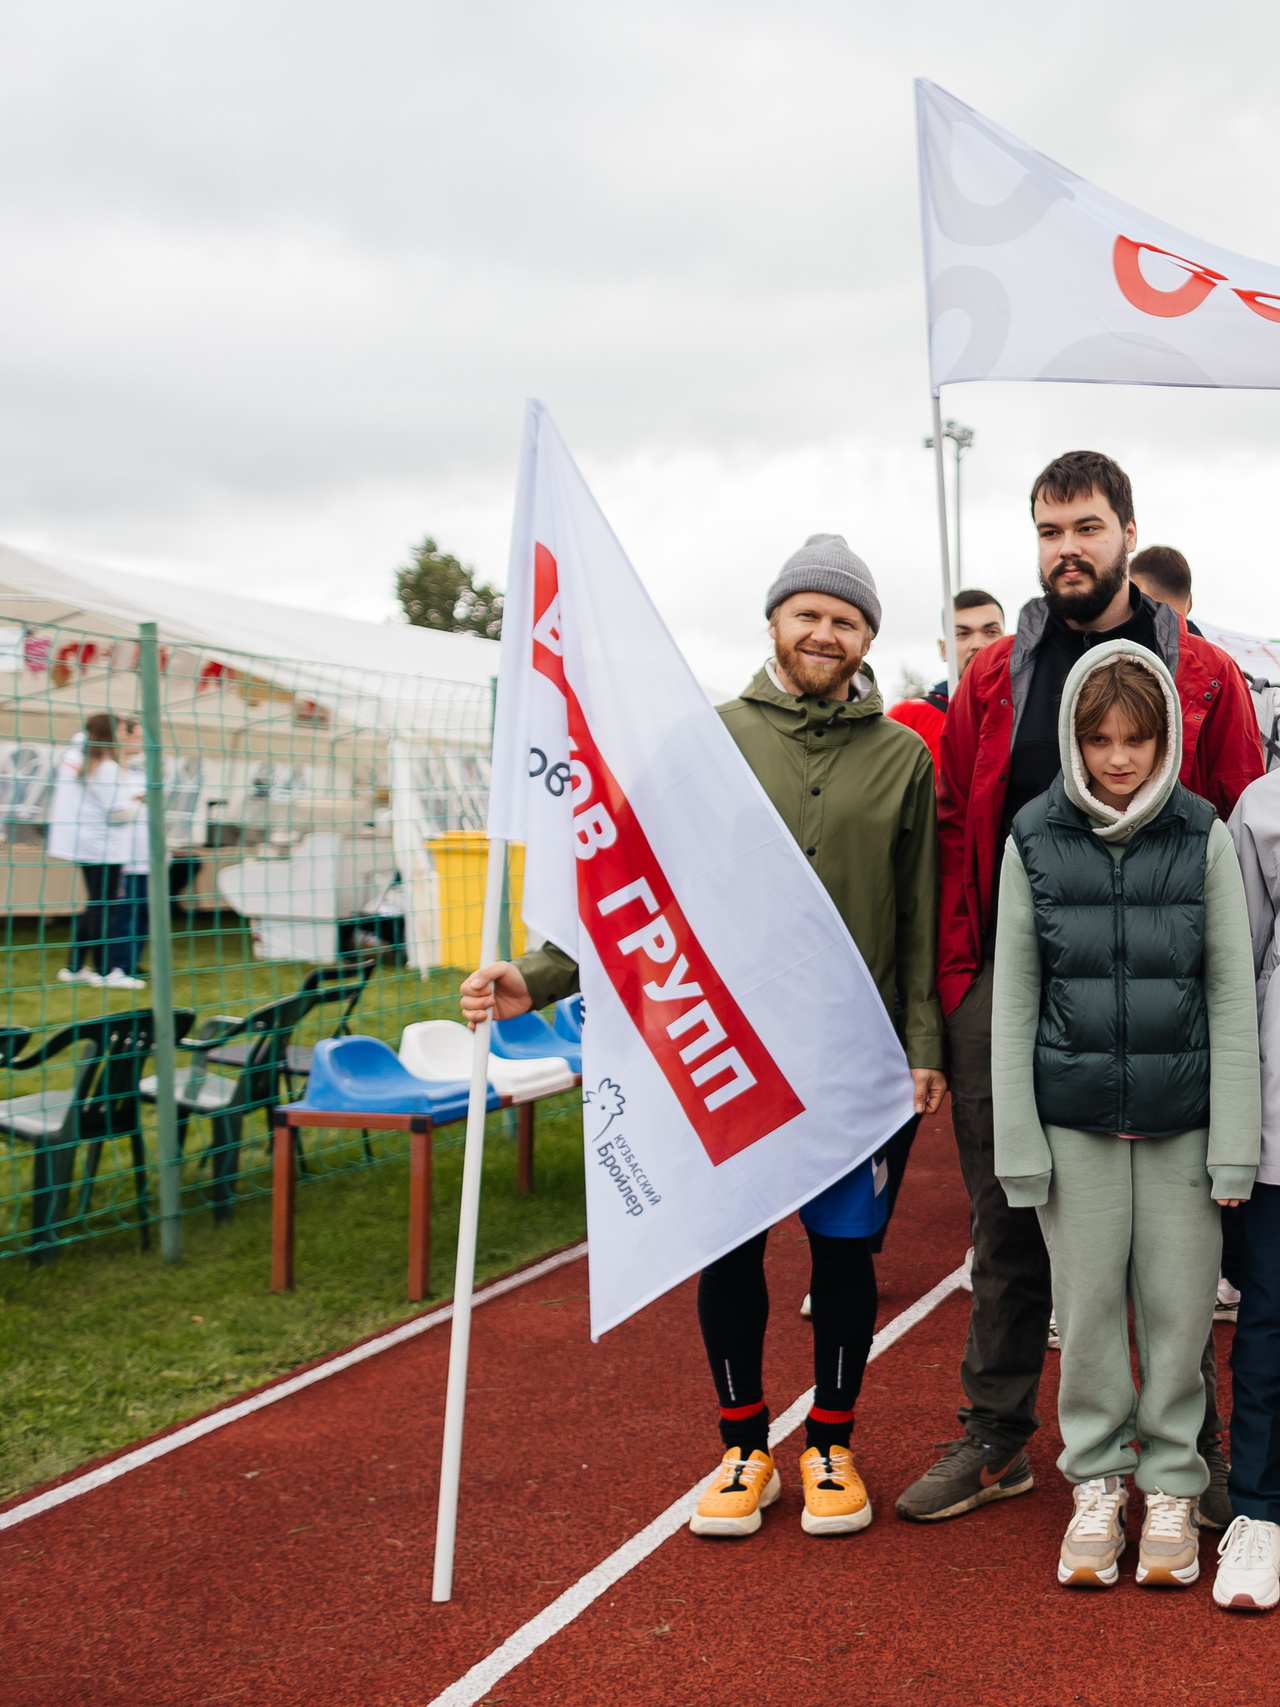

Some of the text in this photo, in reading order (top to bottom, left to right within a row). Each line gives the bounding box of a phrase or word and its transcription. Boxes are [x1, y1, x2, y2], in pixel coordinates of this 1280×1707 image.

[596, 876, 758, 1113] ГРУПП
[596, 1140, 645, 1217] Бройлер
[613, 1133, 663, 1207] КУЗБАССКИЙ
